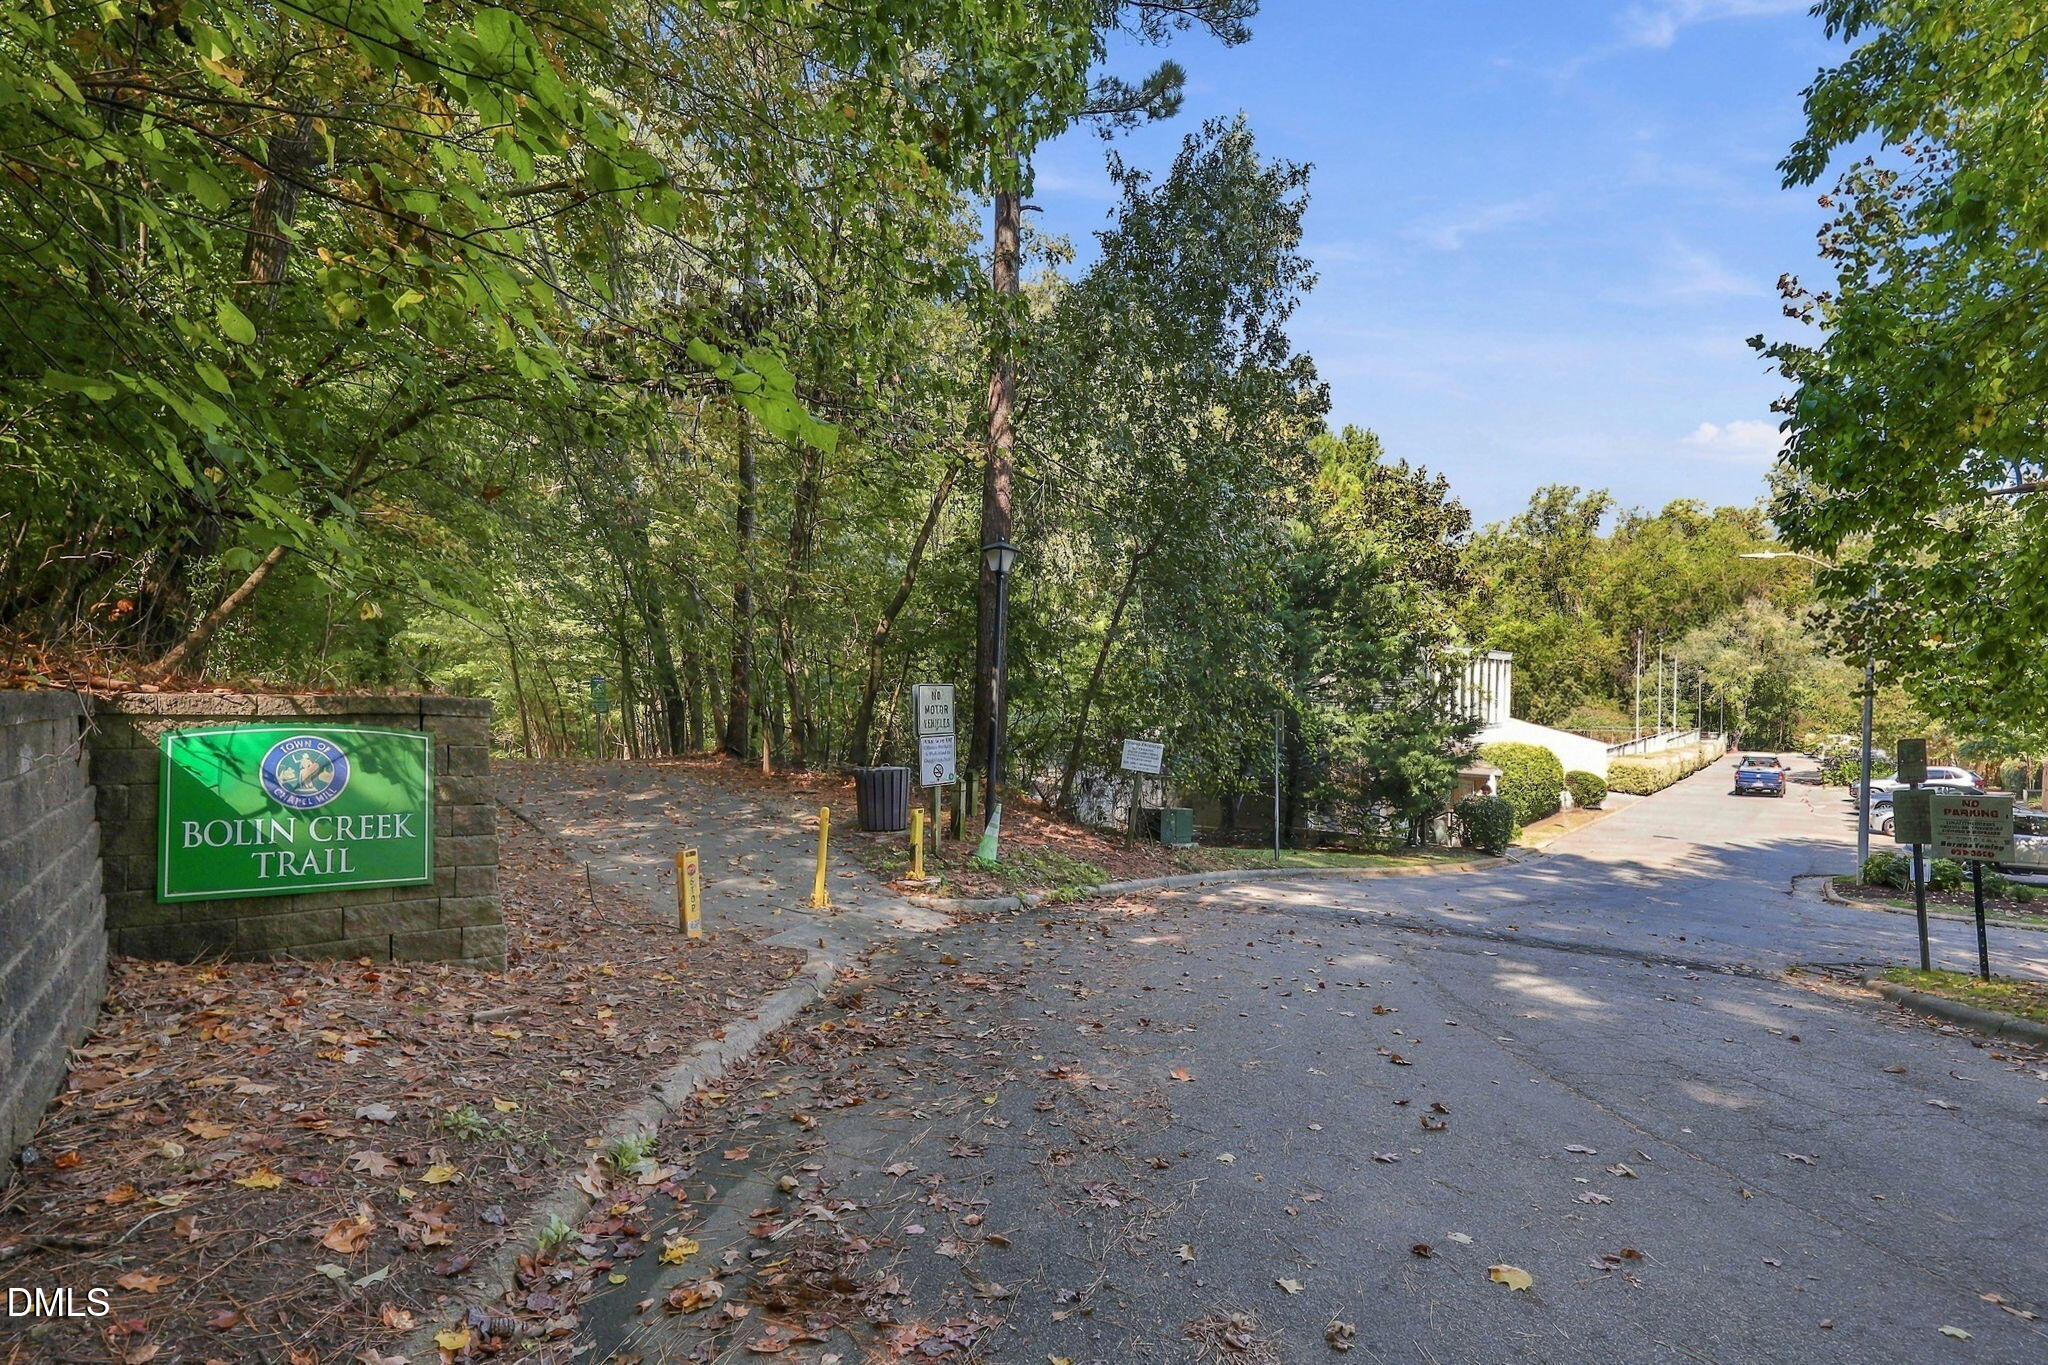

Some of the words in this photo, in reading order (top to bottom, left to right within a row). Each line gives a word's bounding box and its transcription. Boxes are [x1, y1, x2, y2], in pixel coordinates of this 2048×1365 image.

[931, 690, 941, 701] NO
[924, 704, 949, 715] MOTOR
[924, 718, 950, 729] VEHICLES
[280, 740, 312, 753] TOWN
[317, 742, 331, 753] OF
[273, 788, 313, 806] CHAPEL
[315, 787, 337, 802] HILL
[1961, 799, 1980, 808] NO
[1943, 808, 1999, 818] PARKING
[182, 817, 297, 849] BOLIN
[309, 813, 417, 843] CREEK
[251, 848, 356, 879] TRAIL
[688, 877, 696, 912] STOP
